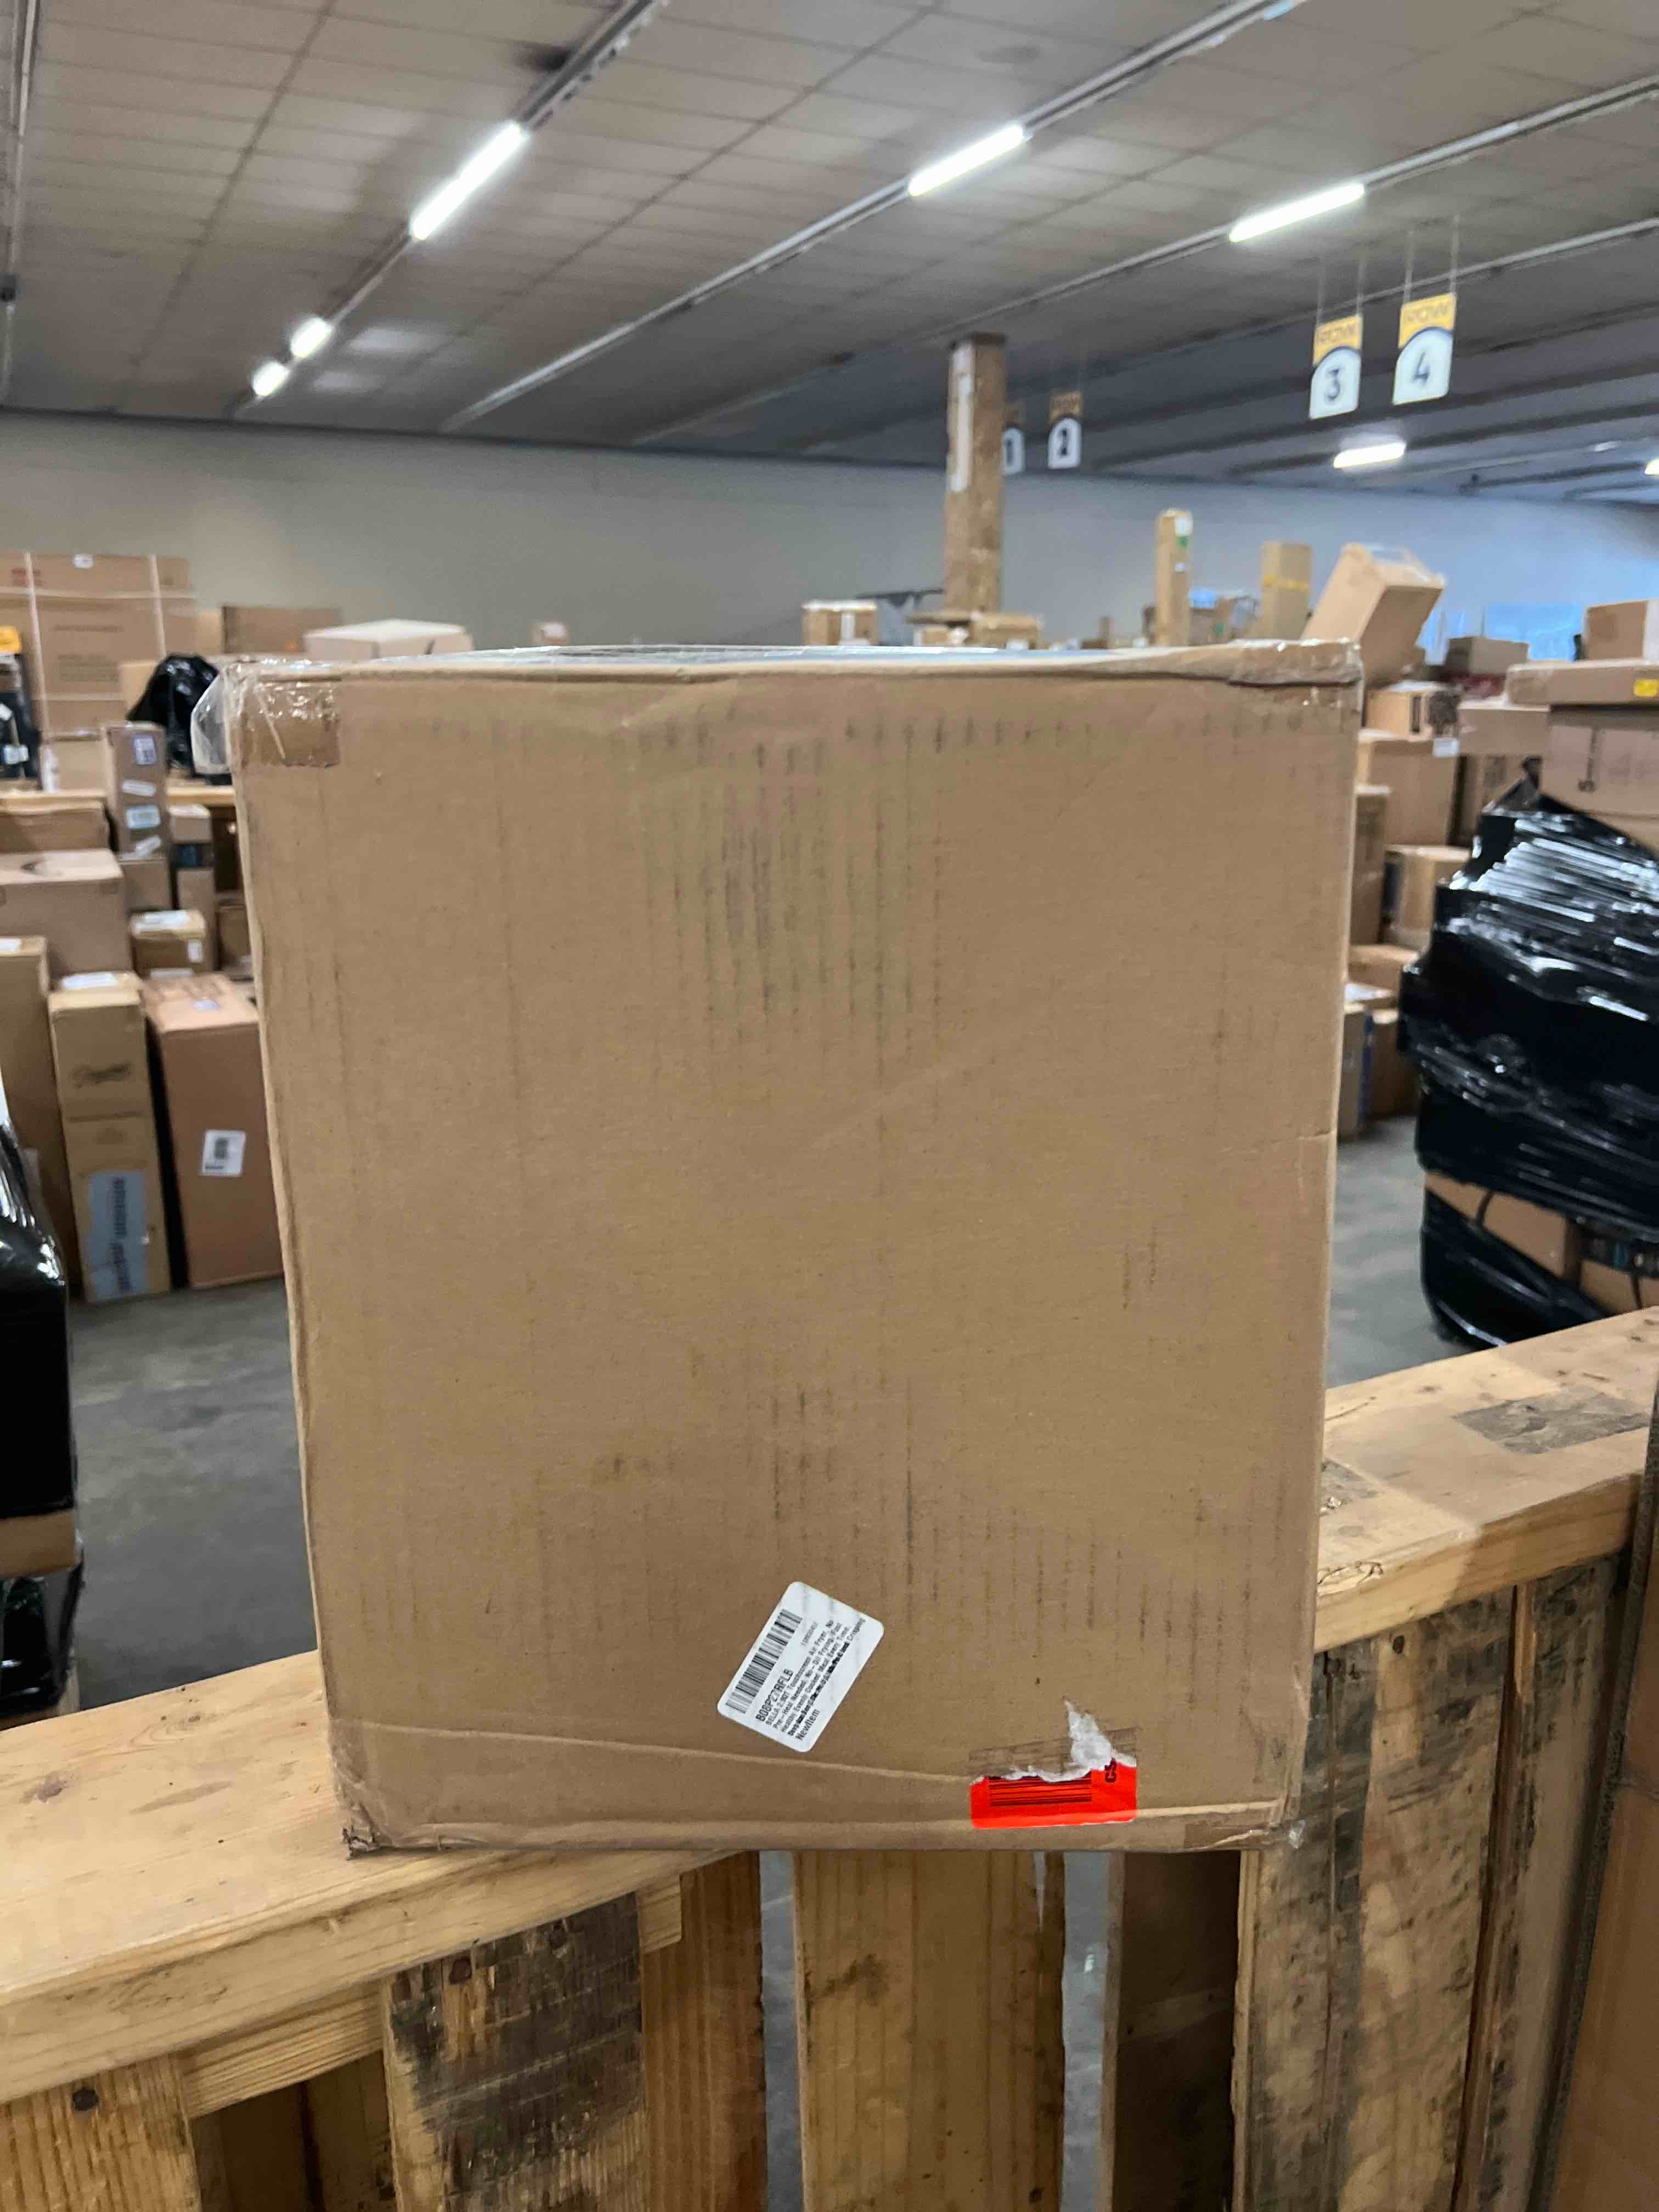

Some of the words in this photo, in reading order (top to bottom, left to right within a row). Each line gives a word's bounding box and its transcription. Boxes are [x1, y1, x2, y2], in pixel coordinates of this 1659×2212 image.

[1327, 367, 1341, 402] 3
[1413, 352, 1430, 385] 4
[765, 1706, 780, 1726] BELLA
[808, 1646, 817, 1656] Air
[825, 1618, 834, 1628] No
[780, 1711, 797, 1733] Healthy
[793, 1692, 808, 1712] Evenly
